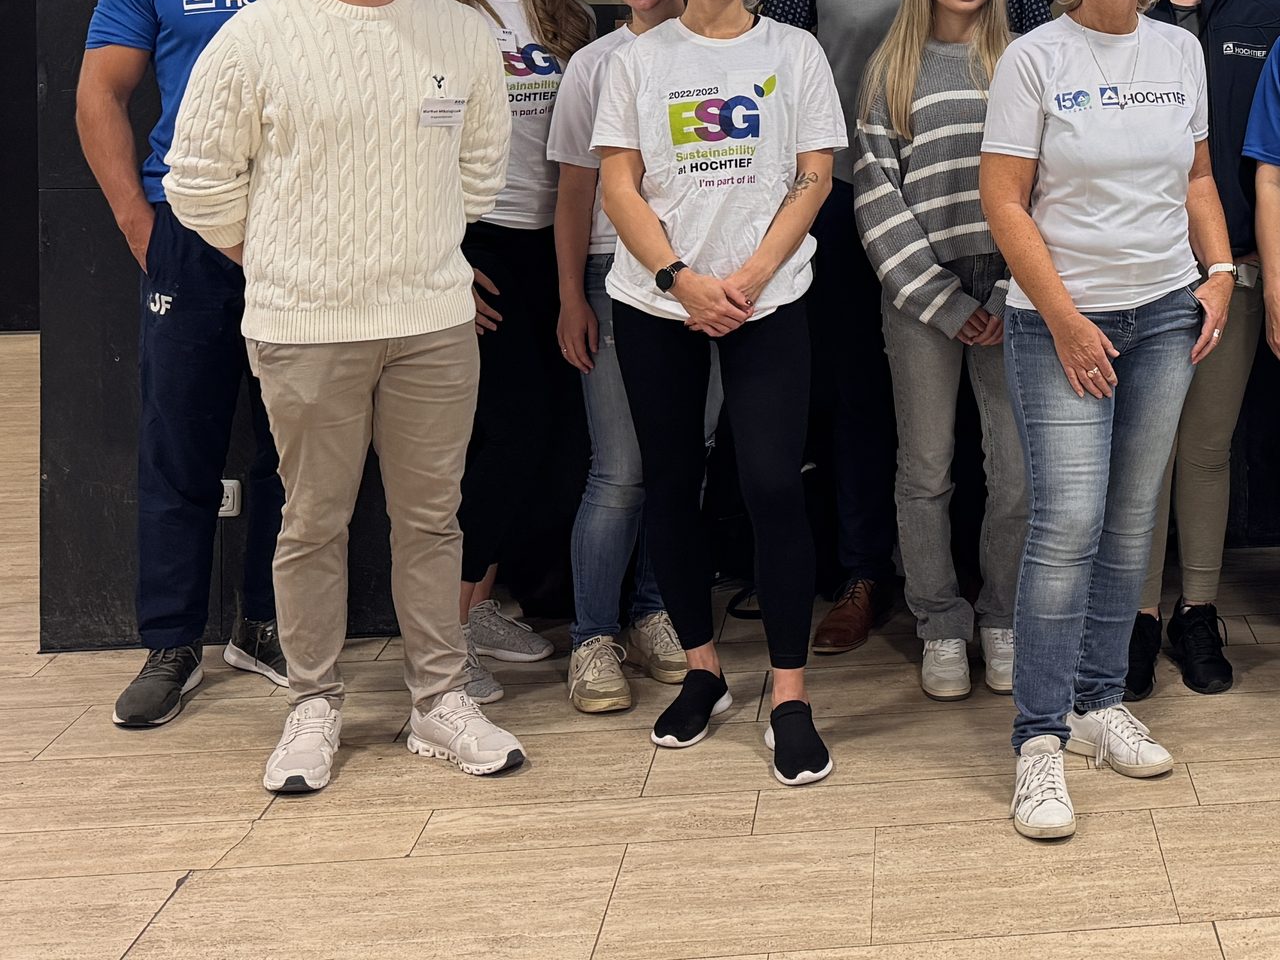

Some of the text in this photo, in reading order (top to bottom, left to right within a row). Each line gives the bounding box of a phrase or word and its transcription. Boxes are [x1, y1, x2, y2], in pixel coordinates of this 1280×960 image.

[506, 80, 560, 92] tainability
[668, 86, 719, 100] 2022/2023
[508, 91, 557, 103] OCHTIEF
[1123, 91, 1186, 106] HOCHTIEF
[668, 95, 760, 147] ESG
[675, 145, 757, 162] Sustainability
[678, 158, 752, 175] at HOCHTIEF
[699, 179, 715, 188] I'm
[716, 178, 734, 188] part
[736, 176, 745, 184] of
